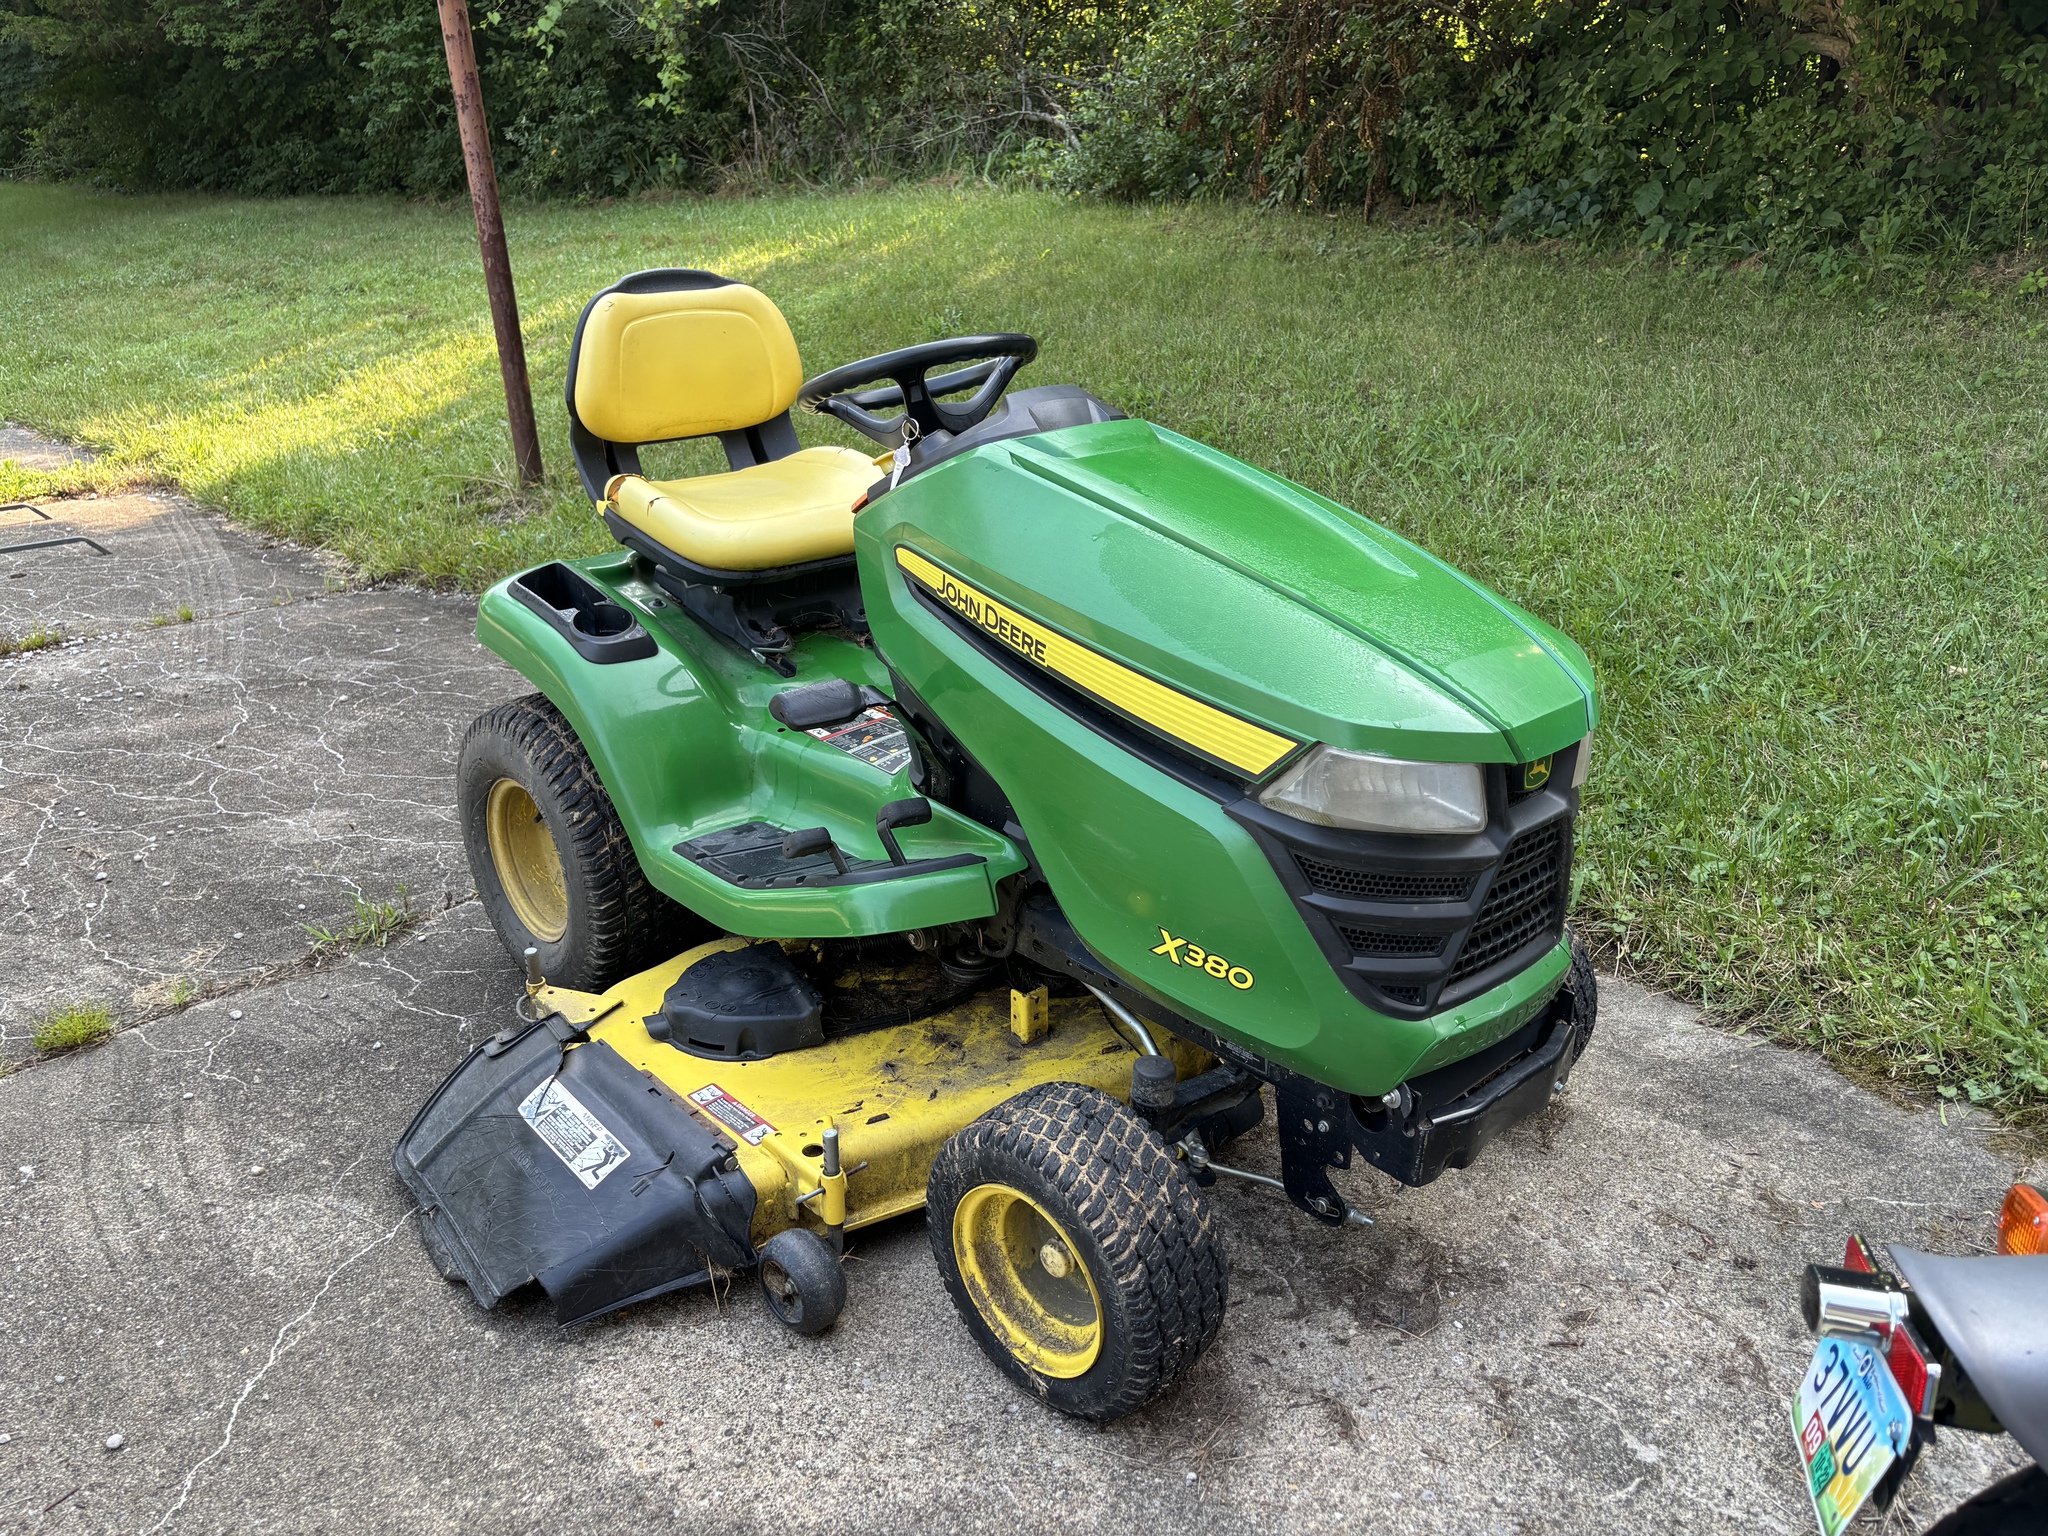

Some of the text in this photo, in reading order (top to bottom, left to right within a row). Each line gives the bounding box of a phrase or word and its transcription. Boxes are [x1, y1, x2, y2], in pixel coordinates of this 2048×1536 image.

[936, 573, 1047, 664] JOHN DEERE
[1148, 925, 1256, 991] X380
[1805, 1417, 1823, 1456] 09
[1813, 1343, 1878, 1477] 37VVU
